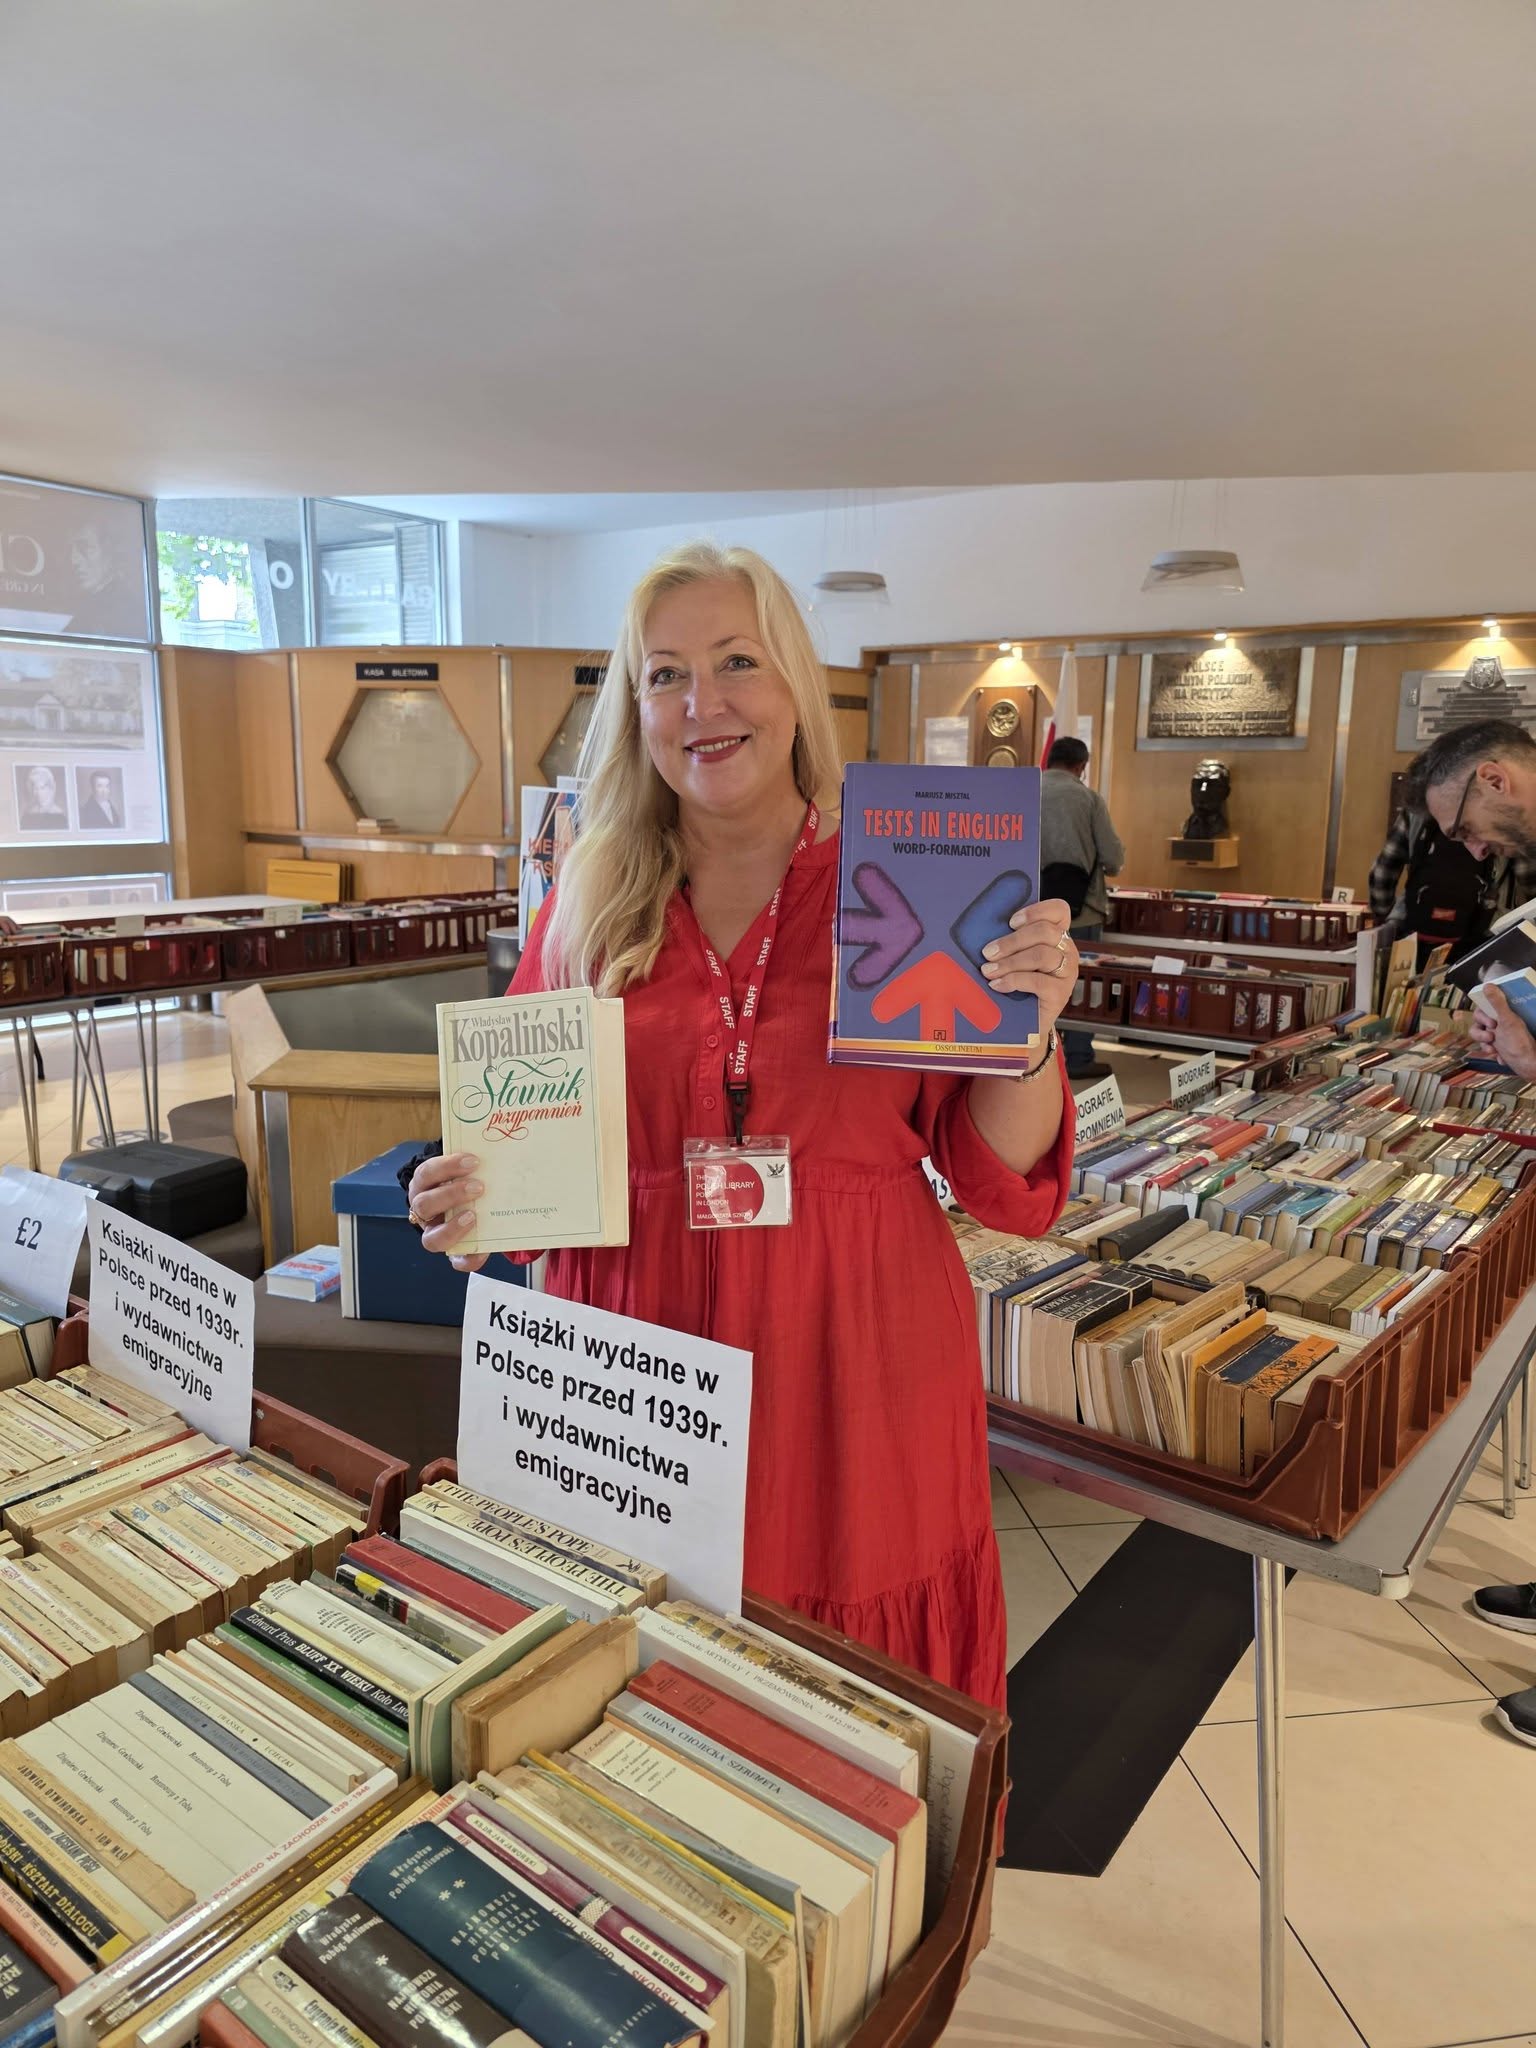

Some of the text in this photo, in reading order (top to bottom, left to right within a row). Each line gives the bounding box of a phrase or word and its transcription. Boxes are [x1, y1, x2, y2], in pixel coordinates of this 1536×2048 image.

[363, 668, 429, 677] KASA BILETOWA
[915, 791, 970, 800] MARIUSZ MISZTAL
[807, 808, 818, 830] STAFF
[863, 808, 1025, 841] TESTS IN ENGLISH
[893, 842, 991, 858] WORD-FORMATION
[1338, 891, 1347, 902] R
[705, 948, 722, 978] STAFF
[756, 936, 772, 966] STAFF
[719, 995, 735, 1030] STAFF
[743, 984, 758, 1017] STAFF
[448, 1005, 585, 1072] Kopaliński
[471, 1016, 511, 1028] Władysław
[734, 1039, 748, 1075] STAFF
[935, 1044, 983, 1053] OSSOLINEUM
[451, 1062, 586, 1122] Słownik
[1177, 1061, 1210, 1088] BIOGRAFIE
[484, 1101, 583, 1138] przypomnień
[1076, 1087, 1115, 1122] IOGRAFIE
[1075, 1107, 1125, 1145] SPOMNIENIA
[724, 1181, 755, 1190] LIBRARY
[490, 1207, 558, 1217] WIEDZA POWSZECHNA
[14, 1217, 43, 1250] £2
[102, 1219, 237, 1308] Książki wydane w
[99, 1248, 244, 1349] Polsce przed 1939r.
[114, 1291, 223, 1374] i wydawnictwa
[489, 1300, 719, 1394] Książki wydane w
[122, 1333, 213, 1402] emigracyjne
[475, 1340, 728, 1447] Polsce przed 1939r.
[502, 1396, 689, 1486] i wydawnictwa
[515, 1449, 672, 1525] emigracyjne
[443, 1485, 595, 1554] THE PEOPLE'S POPE
[466, 1518, 626, 1598] THE PEOPLE'S POPE
[246, 1613, 280, 1640] Edward
[277, 1630, 297, 1647] Prus
[295, 1640, 328, 1665] BLUFF
[323, 1659, 343, 1674] XX
[340, 1667, 374, 1693] WIEKU
[371, 1689, 393, 1706] Koło
[392, 1701, 409, 1717] Lwo
[704, 1649, 744, 1672] ARTYKUŁY
[753, 1674, 814, 1711] PRZEMÓWIENIA
[156, 1724, 184, 1748] Grabowski
[188, 1751, 214, 1774] Rozmowy
[264, 1745, 295, 1768] UCIECZKI
[331, 1717, 361, 1739] OSTRY
[362, 1736, 396, 1762] DYŻUR
[642, 1710, 783, 1795] HALINA CHOJECKA SZEREMETA
[118, 1747, 145, 1771] Grabowski
[150, 1774, 175, 1798] Rozmowy
[16, 1763, 47, 1791] JADWIGA
[44, 1788, 88, 1826] OTWINOWSKA
[111, 1845, 129, 1859] MŁO
[306, 1839, 337, 1861] Historia
[314, 1846, 345, 1869] Historia
[389, 1845, 433, 1880] Władysław
[506, 1843, 538, 1867] JAWORSKI
[388, 1846, 455, 1900] Pobóg-Malinowski
[6, 1893, 24, 1914] BATTLE
[21, 1909, 30, 1920] OF
[29, 1915, 40, 1929] THE
[20, 1862, 60, 1898] KSZTAŁT
[55, 1896, 100, 1937] DIALOGU
[104, 1941, 151, 1978] TECHNICY
[154, 1899, 210, 1942] LOTNICTWA
[212, 1861, 266, 1900] POLSKIEGO
[266, 1851, 281, 1863] NA
[281, 1815, 329, 1852] ZACHODZIE
[318, 1912, 363, 1947] Władysław
[450, 1890, 518, 1947] NAJNOWSZA
[467, 1903, 521, 1947] HISTORIA
[471, 1907, 539, 1964] POLITYCZNA
[318, 1917, 384, 1965] Pobóg-Malinowski
[490, 1919, 542, 1962] POLSKI
[629, 1934, 695, 1985] KRES WĘDRÓWKI
[387, 1968, 437, 2012] NAJNOWSZA
[403, 1980, 445, 2015] HIORIA
[632, 1970, 678, 2009] SIKORSKI
[271, 2006, 314, 2046] OTWINOWSKA
[304, 1999, 339, 2032] Eugenia
